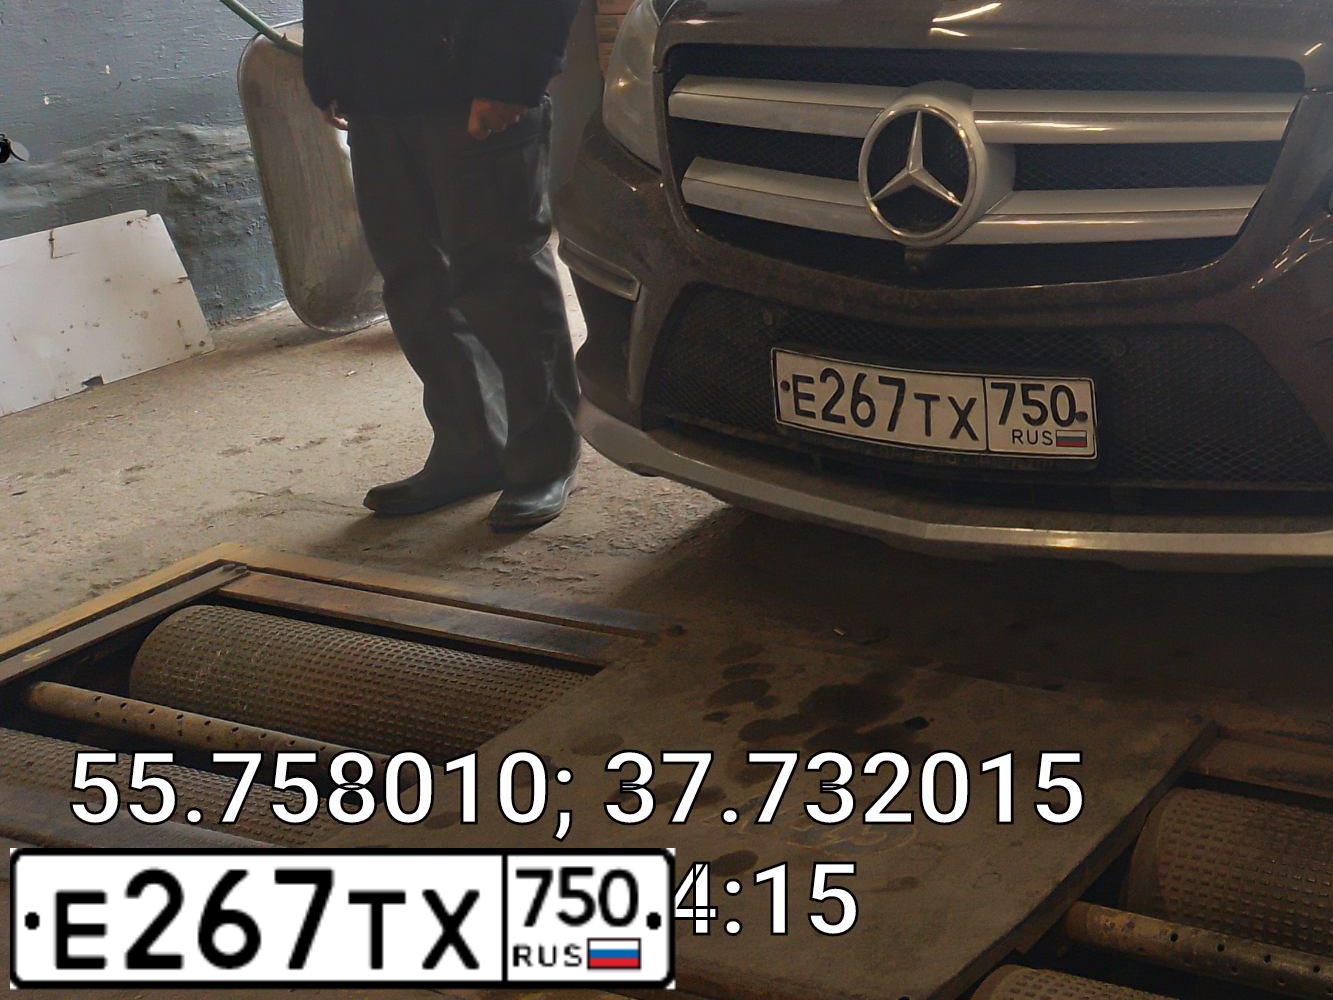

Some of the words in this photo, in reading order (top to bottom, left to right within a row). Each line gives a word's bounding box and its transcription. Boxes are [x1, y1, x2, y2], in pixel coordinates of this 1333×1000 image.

[792, 368, 980, 441] E267TX
[991, 382, 1077, 427] 750
[1011, 429, 1053, 446] RUS
